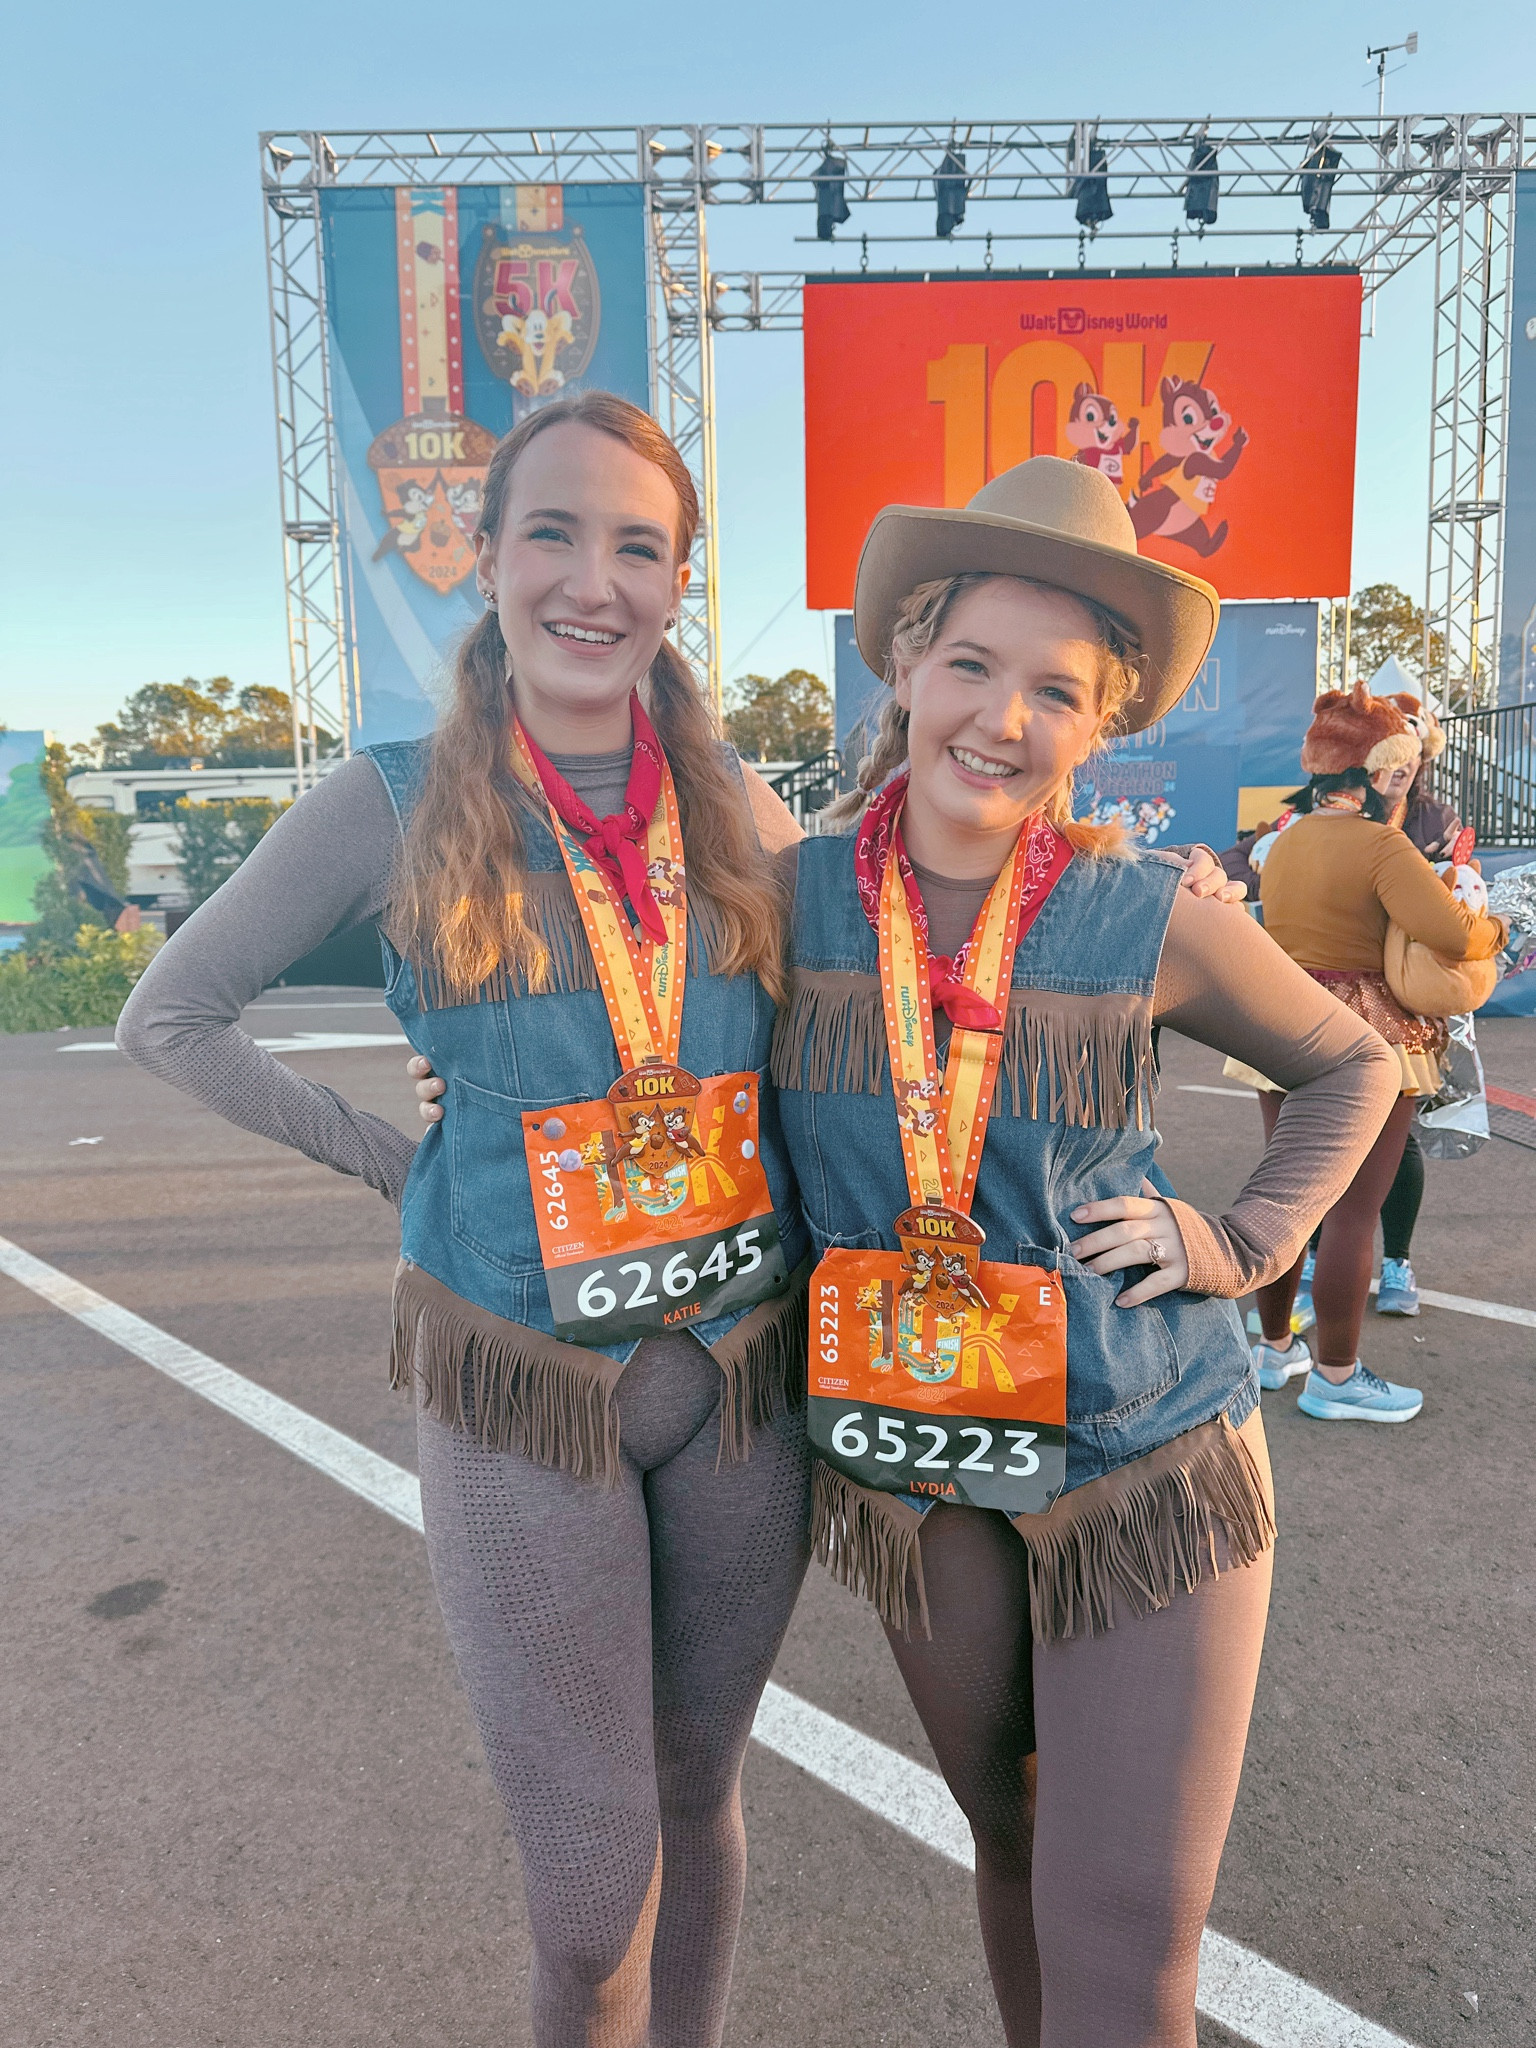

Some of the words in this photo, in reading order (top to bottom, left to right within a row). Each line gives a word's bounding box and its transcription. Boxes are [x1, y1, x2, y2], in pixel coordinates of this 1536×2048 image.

[494, 260, 581, 319] 5K
[1020, 313, 1056, 330] Walt
[1125, 313, 1168, 329] World
[404, 431, 466, 460] 10K
[634, 1076, 676, 1097] 10K
[650, 1160, 669, 1170] 2024
[540, 1150, 569, 1231] 62645
[655, 1214, 685, 1232] 2024
[916, 1217, 957, 1239] 10K
[551, 1241, 585, 1255] CITIZEN
[577, 1228, 763, 1318] 62645
[936, 1300, 955, 1311] 2024
[1039, 1286, 1052, 1306] E
[663, 1302, 702, 1326] KATIE
[820, 1285, 839, 1364] 65223
[817, 1376, 850, 1387] CITIZEN
[917, 1385, 947, 1403] 2024
[831, 1411, 1040, 1477] 65223
[910, 1480, 956, 1496] LYDIA
